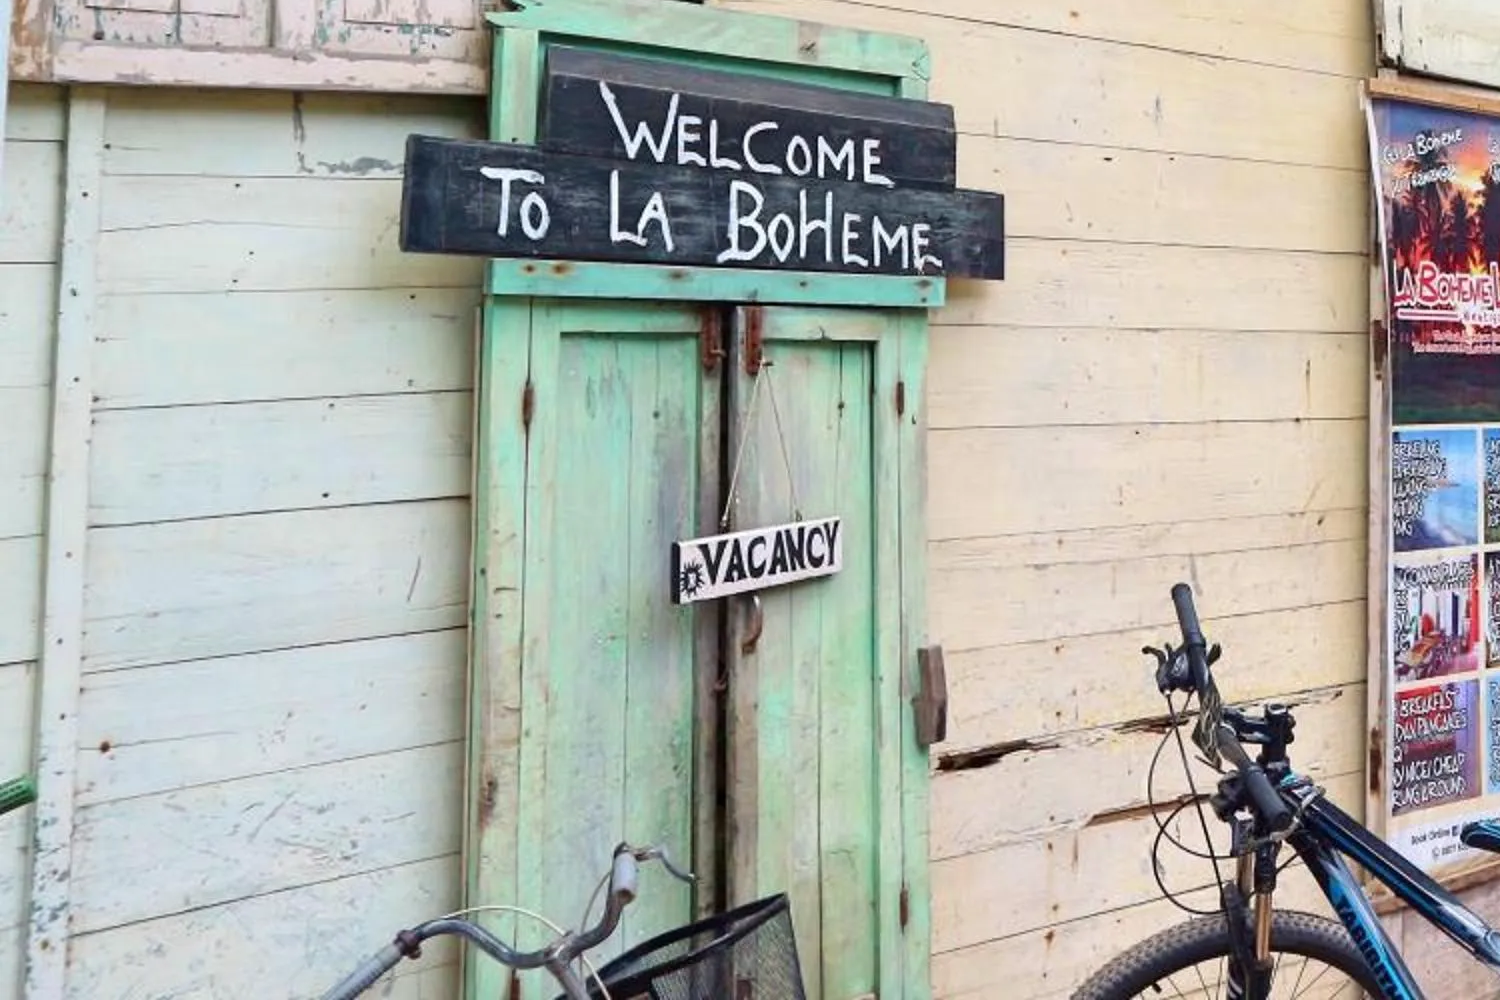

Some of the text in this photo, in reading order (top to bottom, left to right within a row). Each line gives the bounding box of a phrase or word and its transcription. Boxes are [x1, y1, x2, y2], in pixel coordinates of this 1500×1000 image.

[600, 80, 895, 188] WELCOME
[480, 166, 943, 271] TO LA BOHEME
[1393, 258, 1413, 306] LA
[1415, 261, 1491, 307] BOHEME
[698, 519, 840, 586] VACANCY
